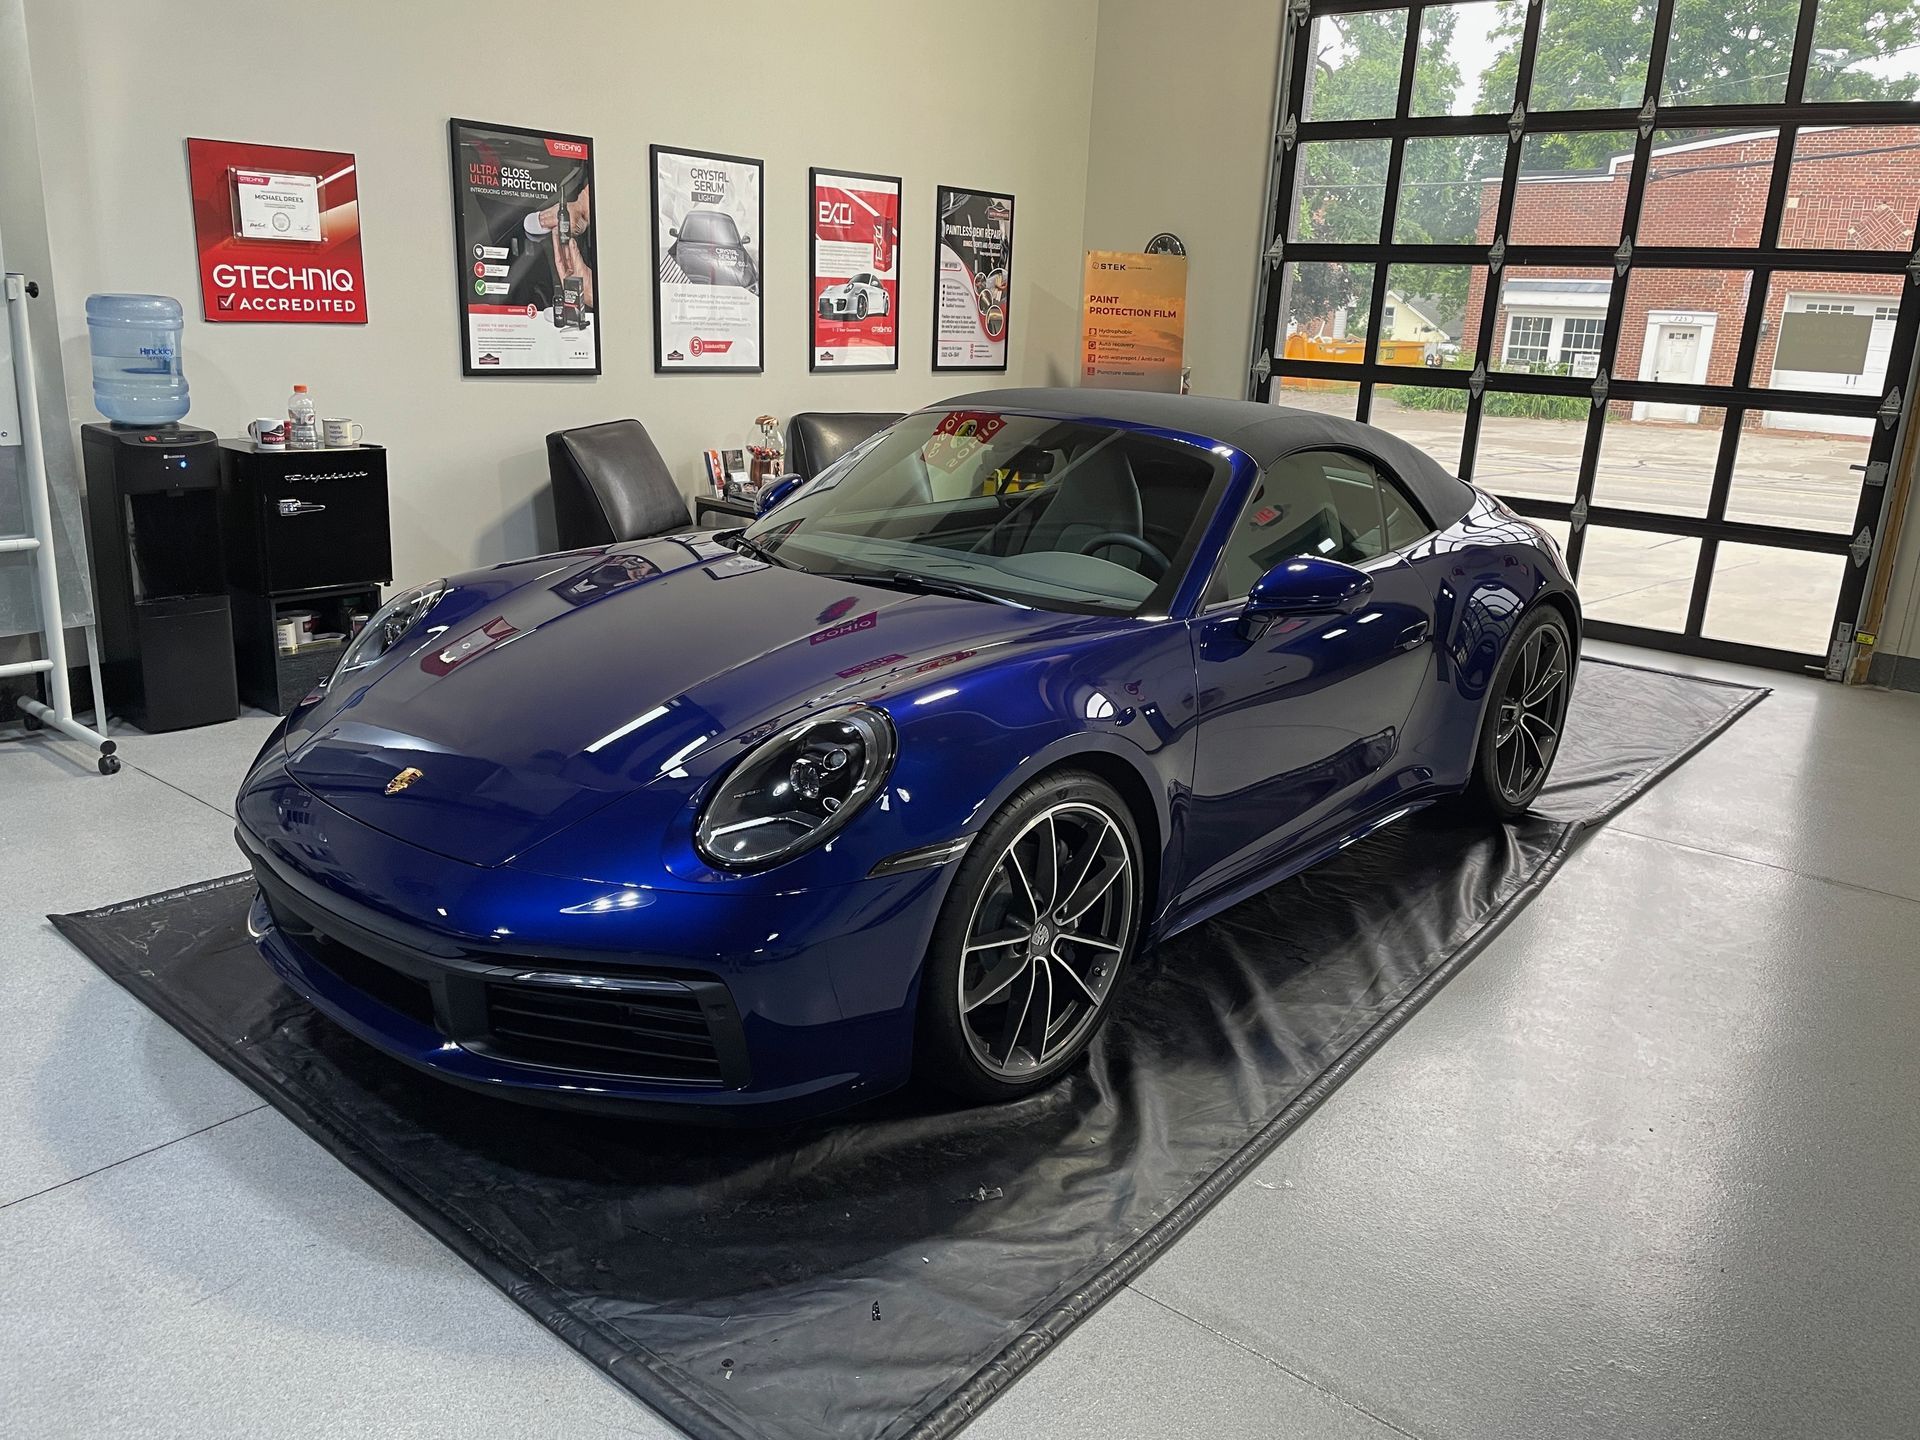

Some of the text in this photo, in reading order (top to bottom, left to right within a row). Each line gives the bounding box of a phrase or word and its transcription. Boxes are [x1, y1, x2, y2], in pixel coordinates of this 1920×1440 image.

[554, 143, 582, 152] GTECHNIQ
[470, 163, 532, 180] ULTRA GLOSS,
[690, 168, 729, 183] CRYSTAL
[470, 174, 558, 192] ULTRA PROTECTION
[694, 181, 724, 194] SERUM
[470, 186, 500, 195] INTRODUCING
[255, 194, 283, 202] MICHAEL
[698, 194, 715, 202] LIGHT
[946, 224, 972, 236] PAINTLESS
[1100, 263, 1126, 271] STEK
[213, 264, 354, 292] GTECHNIQ
[239, 297, 356, 312] ACCREDITED
[1090, 295, 1119, 304] PAINT
[1089, 306, 1177, 318] PROTECTION FILM
[693, 341, 699, 350] 5
[284, 471, 368, 483] Frigidaire
